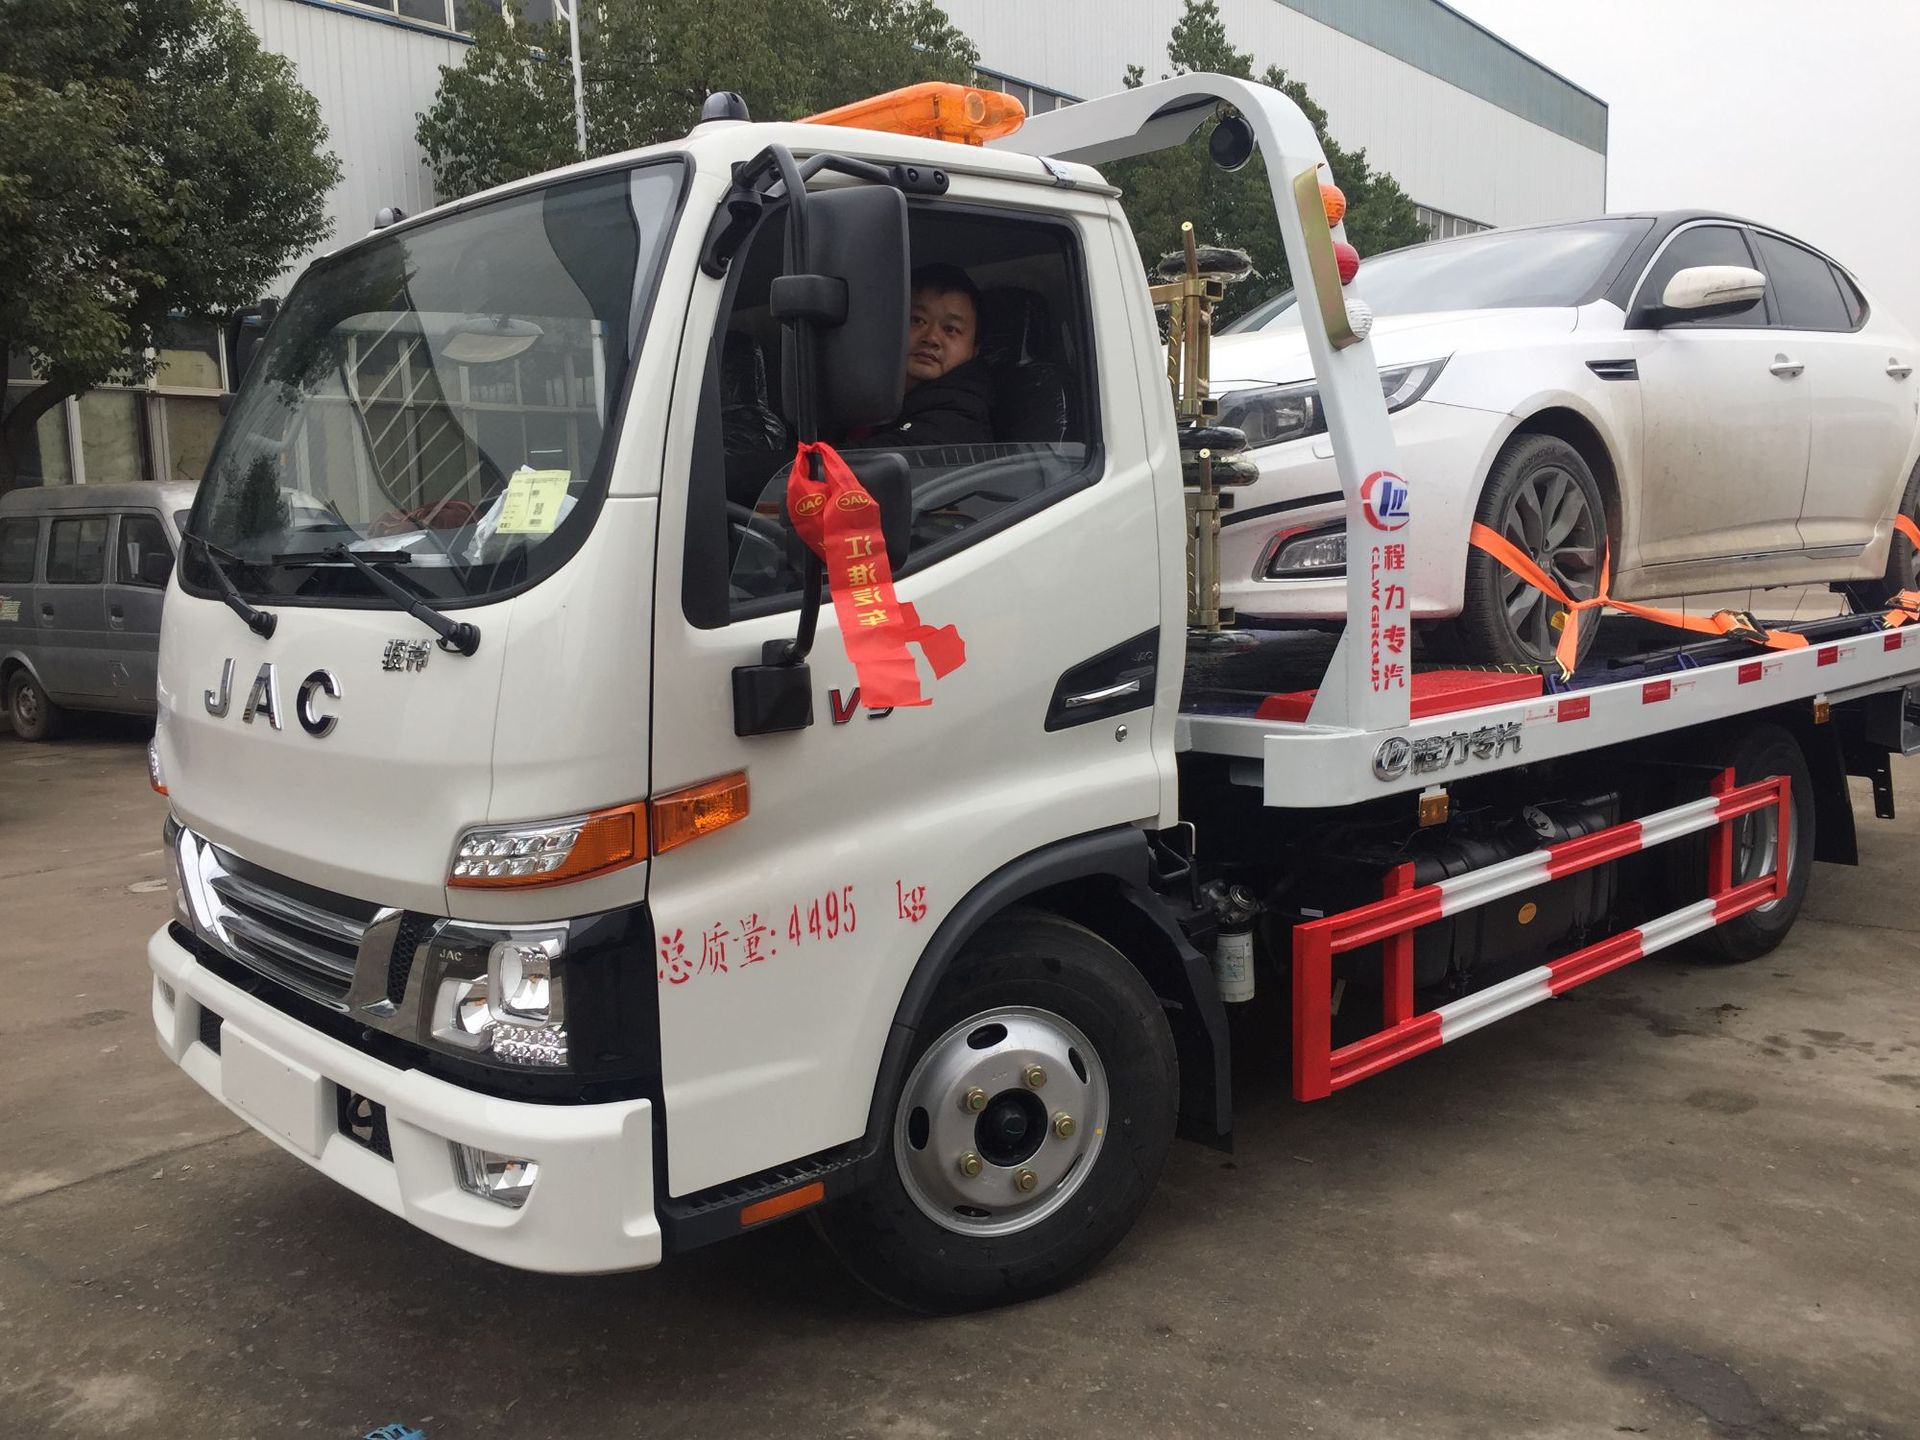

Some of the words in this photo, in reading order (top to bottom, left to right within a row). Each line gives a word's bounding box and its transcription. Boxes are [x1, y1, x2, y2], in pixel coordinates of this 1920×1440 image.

[799, 496, 824, 512] JAC
[1383, 544, 1406, 691] 程力专汽
[204, 657, 342, 738] JAC
[895, 879, 927, 923] kg
[439, 948, 463, 962] JAC
